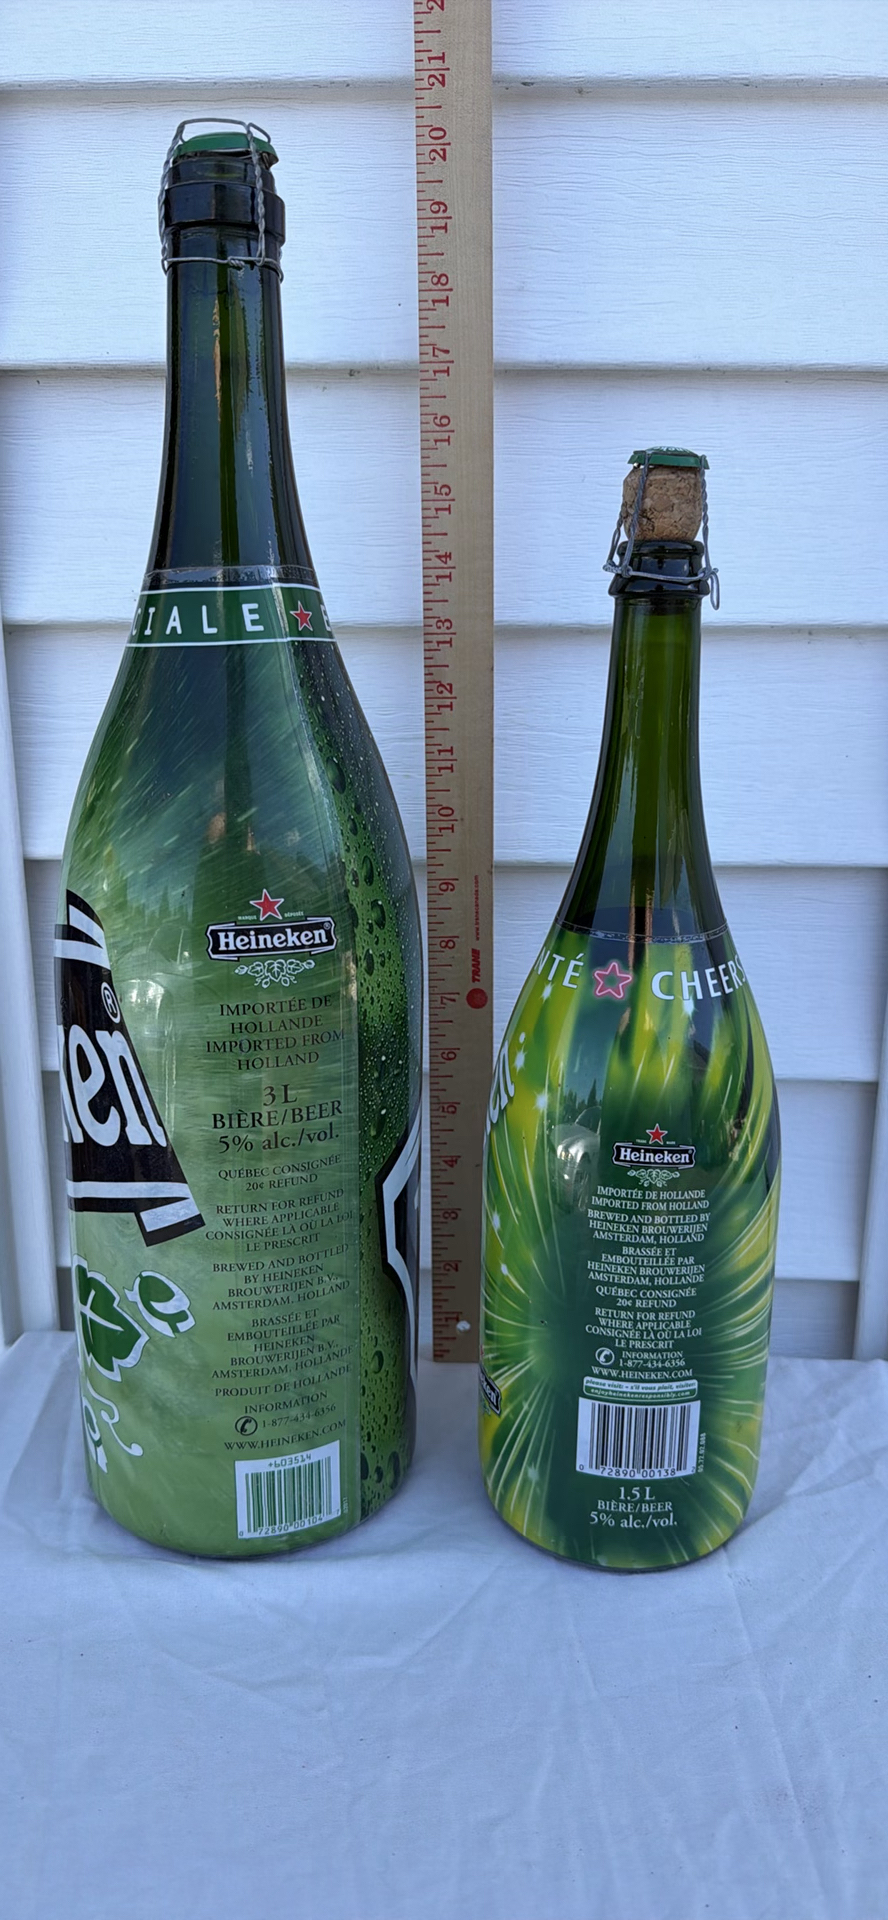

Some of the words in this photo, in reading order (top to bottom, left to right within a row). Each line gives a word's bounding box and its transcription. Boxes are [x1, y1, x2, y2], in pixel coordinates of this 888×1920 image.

[439, 882, 455, 892] 9
[218, 928, 328, 950] Heineken
[440, 939, 455, 950] 8
[472, 948, 480, 983] TRANE
[651, 955, 746, 1000] CHEERS
[220, 996, 306, 1016] IMPORTÉE
[312, 995, 332, 1009] DE
[441, 996, 456, 1005] 7
[231, 1015, 323, 1034] HOLLANDE
[206, 1037, 296, 1053] IMPORTED
[302, 1029, 345, 1046] FROM
[237, 1052, 319, 1070] HOLLAND
[441, 1051, 456, 1061] 6
[263, 1086, 276, 1106] 3
[282, 1084, 298, 1103] L
[212, 1100, 342, 1129] BIÈRE/BEER
[441, 1105, 457, 1114] 5
[219, 1134, 253, 1153] 5%
[262, 1122, 339, 1150] alc./vol.
[443, 1157, 458, 1168] 4
[620, 1148, 690, 1163] Heineken
[218, 1167, 270, 1182] QUÉBEC
[272, 1154, 341, 1175] CONSIGNÉE
[246, 1182, 264, 1191] 20¢
[269, 1173, 317, 1189] REFUND
[597, 1186, 642, 1199] IMPORTÉE
[645, 1191, 658, 1199] DE
[660, 1190, 705, 1199] HOLLANDE
[216, 1202, 267, 1214] RETURN
[272, 1200, 296, 1211] FOR
[299, 1188, 344, 1206] REFUND
[592, 1196, 639, 1210] IMPORTED
[641, 1202, 666, 1211] FROM
[669, 1200, 709, 1211] HOLLAND
[222, 1214, 268, 1227] WHERE
[271, 1202, 339, 1223] APPLICABLE
[443, 1210, 458, 1220] 3
[588, 1209, 628, 1222] BREWED
[630, 1215, 652, 1224] AND
[654, 1214, 698, 1224] BOTTLED
[700, 1213, 711, 1221] BY
[206, 1227, 279, 1240] CONSIGNÉE
[282, 1223, 296, 1234] LÀ
[300, 1219, 317, 1231] OÙ
[320, 1218, 334, 1227] LA
[337, 1211, 353, 1223] LOI
[589, 1220, 639, 1233] HEINEKEN
[642, 1223, 708, 1236] BROUWERIJEN
[246, 1242, 260, 1251] LE
[264, 1232, 320, 1250] PRESCRIT
[593, 1231, 656, 1244] AMSTERDAM,
[660, 1233, 704, 1244] HOLLAND
[213, 1261, 264, 1272] BREWED
[268, 1257, 294, 1270] AND
[299, 1243, 349, 1263] BOTTLED
[622, 1246, 662, 1256] BRASSÉE
[665, 1248, 676, 1256] ET
[444, 1262, 458, 1272] 2
[602, 1254, 675, 1266] EMBOUTEILLÉE
[678, 1256, 695, 1264] PAR
[244, 1274, 259, 1284] BY
[263, 1263, 324, 1281] HEINEKEN
[587, 1261, 637, 1274] HEINEKEN
[640, 1264, 705, 1276] BROUWERIJEN
[588, 1272, 651, 1286] AMSTERDAM,
[654, 1274, 704, 1286] HOLLANDE
[213, 1296, 294, 1310] AMSTERDAM,
[298, 1280, 350, 1302] HOLLAND
[228, 1279, 313, 1298] BROUWERIJEN
[596, 1284, 638, 1298] QUÉBEC
[640, 1287, 697, 1298] CONSIGNÉE
[616, 1298, 632, 1307] 20¢
[635, 1300, 676, 1308] REFUND
[252, 1311, 301, 1328] BRASSÉE
[305, 1308, 319, 1318] ET
[595, 1307, 634, 1319] RETURN
[636, 1312, 655, 1320] FOR
[658, 1310, 695, 1320] REFUND
[228, 1320, 318, 1341] EMBOUTEILLÉE
[322, 1314, 340, 1327] PAR
[599, 1318, 633, 1329] WHERE
[636, 1320, 691, 1330] APPLICABLE
[586, 1325, 640, 1339] CONSIGNÉE
[643, 1330, 654, 1339] LÀ
[657, 1329, 671, 1339] OÙ
[674, 1329, 685, 1338] LA
[687, 1328, 702, 1337] LOI
[254, 1335, 315, 1352] HEINEKEN
[615, 1339, 626, 1347] LE
[629, 1340, 674, 1348] PRESCRIT
[231, 1347, 313, 1366] BROUWERIJEN
[622, 1351, 683, 1359] INFORMATION
[620, 1359, 685, 1368] 1-877-434-6356
[212, 1364, 292, 1379] AMSTERDAM,
[591, 1366, 692, 1379] WWW.HEINEKEN.COM
[215, 1385, 270, 1397] PRODUIT
[274, 1382, 290, 1393] DE
[586, 1379, 606, 1387] please
[591, 1388, 690, 1399] enjoyheinekenresponsibly.com
[244, 1391, 328, 1414] INFORMATION
[262, 1403, 336, 1428] 1-877-434-6356
[224, 1419, 346, 1450] WWW.HEINEKEN.COM
[601, 1467, 635, 1478] 72890
[642, 1468, 676, 1478] 00138
[619, 1487, 640, 1500] 1.5
[645, 1487, 655, 1499] L
[598, 1500, 673, 1512] BIÈRE/BEER
[258, 1525, 289, 1535] 72890
[294, 1516, 322, 1529] 00104
[589, 1511, 615, 1526] 5%
[620, 1512, 677, 1528] alc./vol.
